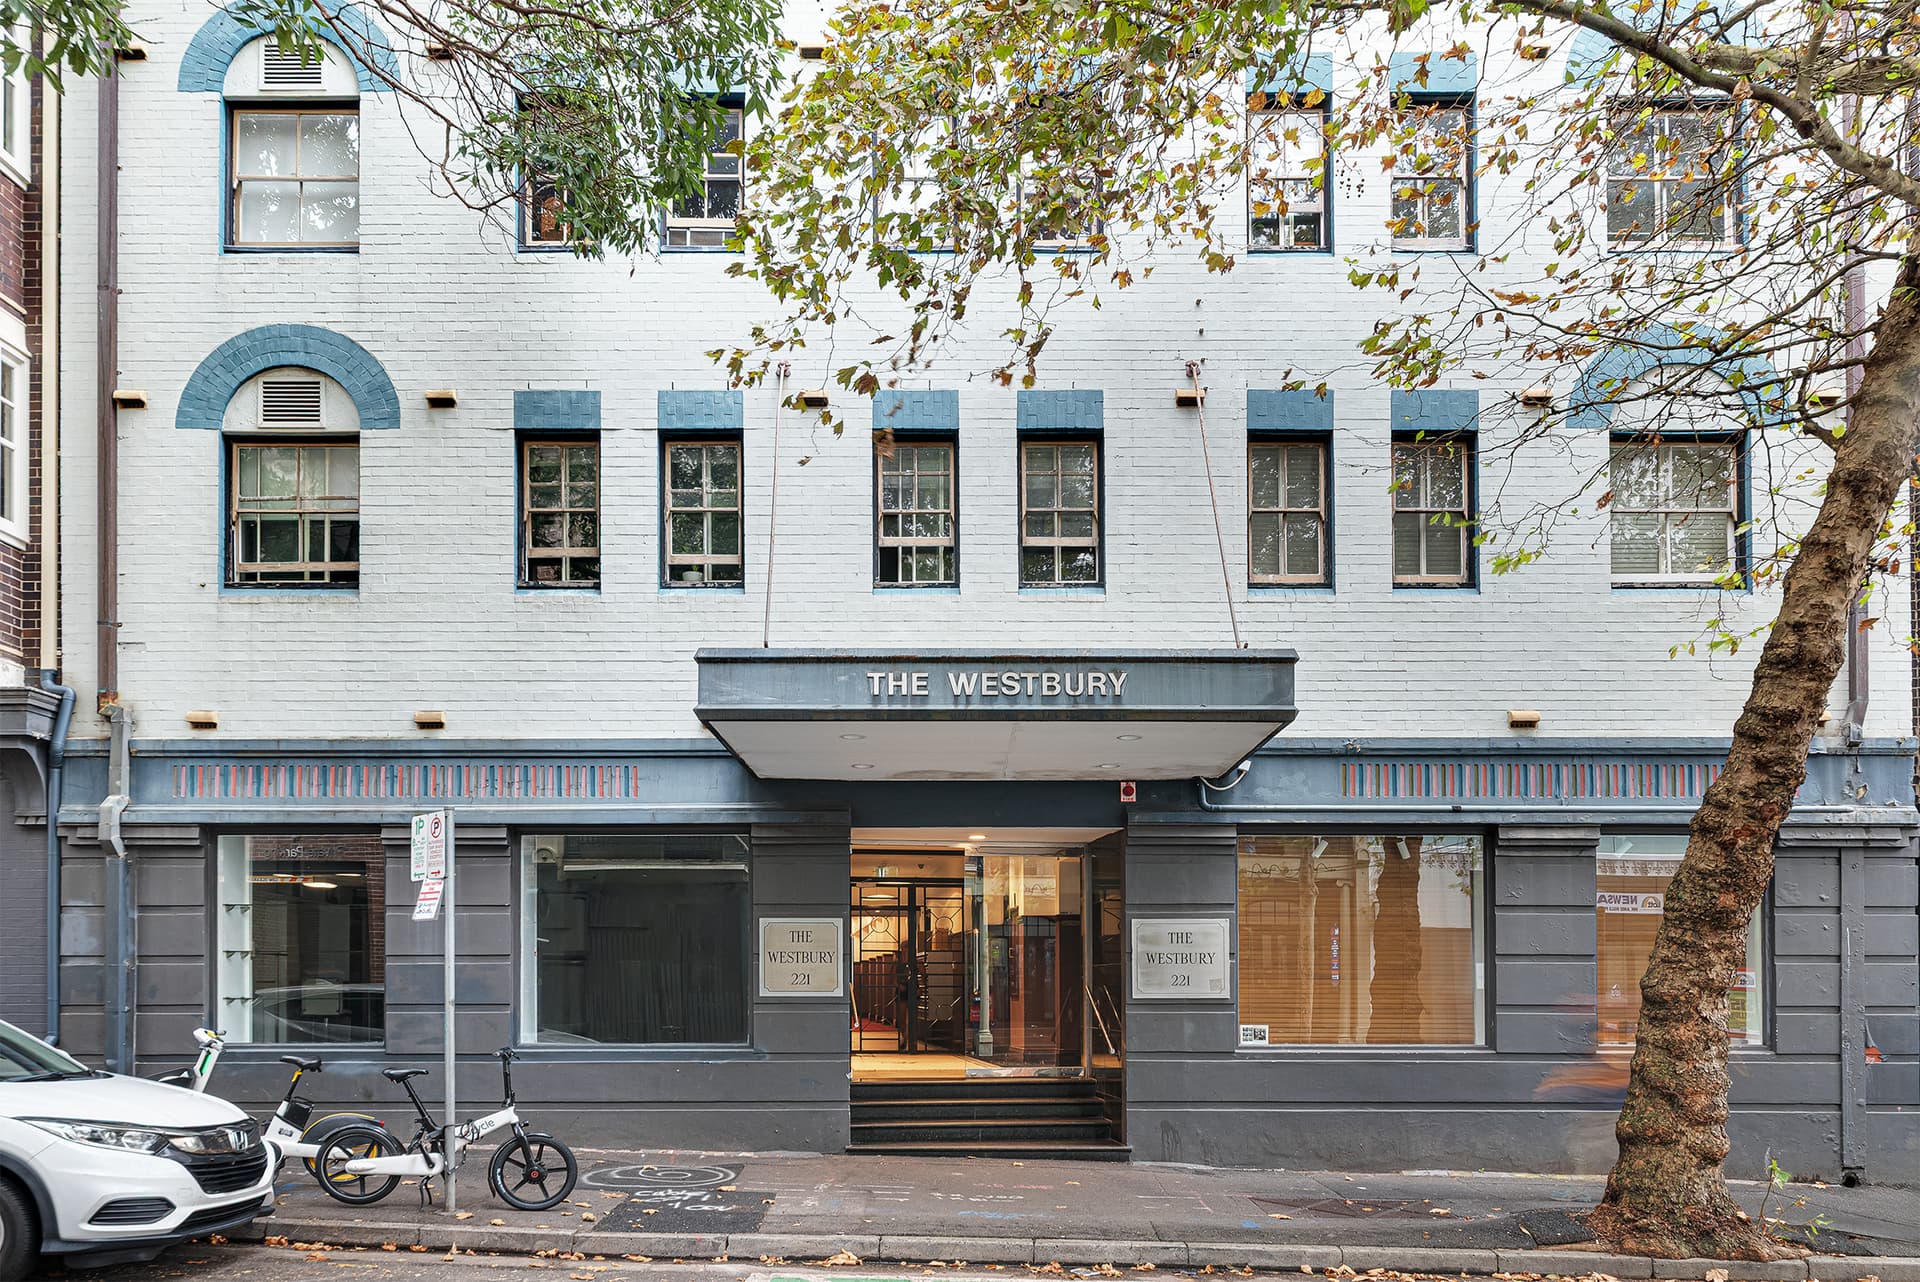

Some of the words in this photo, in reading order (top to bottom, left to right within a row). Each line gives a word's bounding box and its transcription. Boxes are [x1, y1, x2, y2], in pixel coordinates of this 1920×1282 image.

[866, 672, 929, 696] THE
[948, 671, 1128, 696] WESTBURY
[789, 930, 814, 943] THE
[1168, 932, 1193, 944] THE
[768, 951, 835, 964] WESTBURY
[1146, 952, 1216, 965] WESTBURY
[791, 972, 810, 985] 221
[1170, 974, 1190, 987] 221
